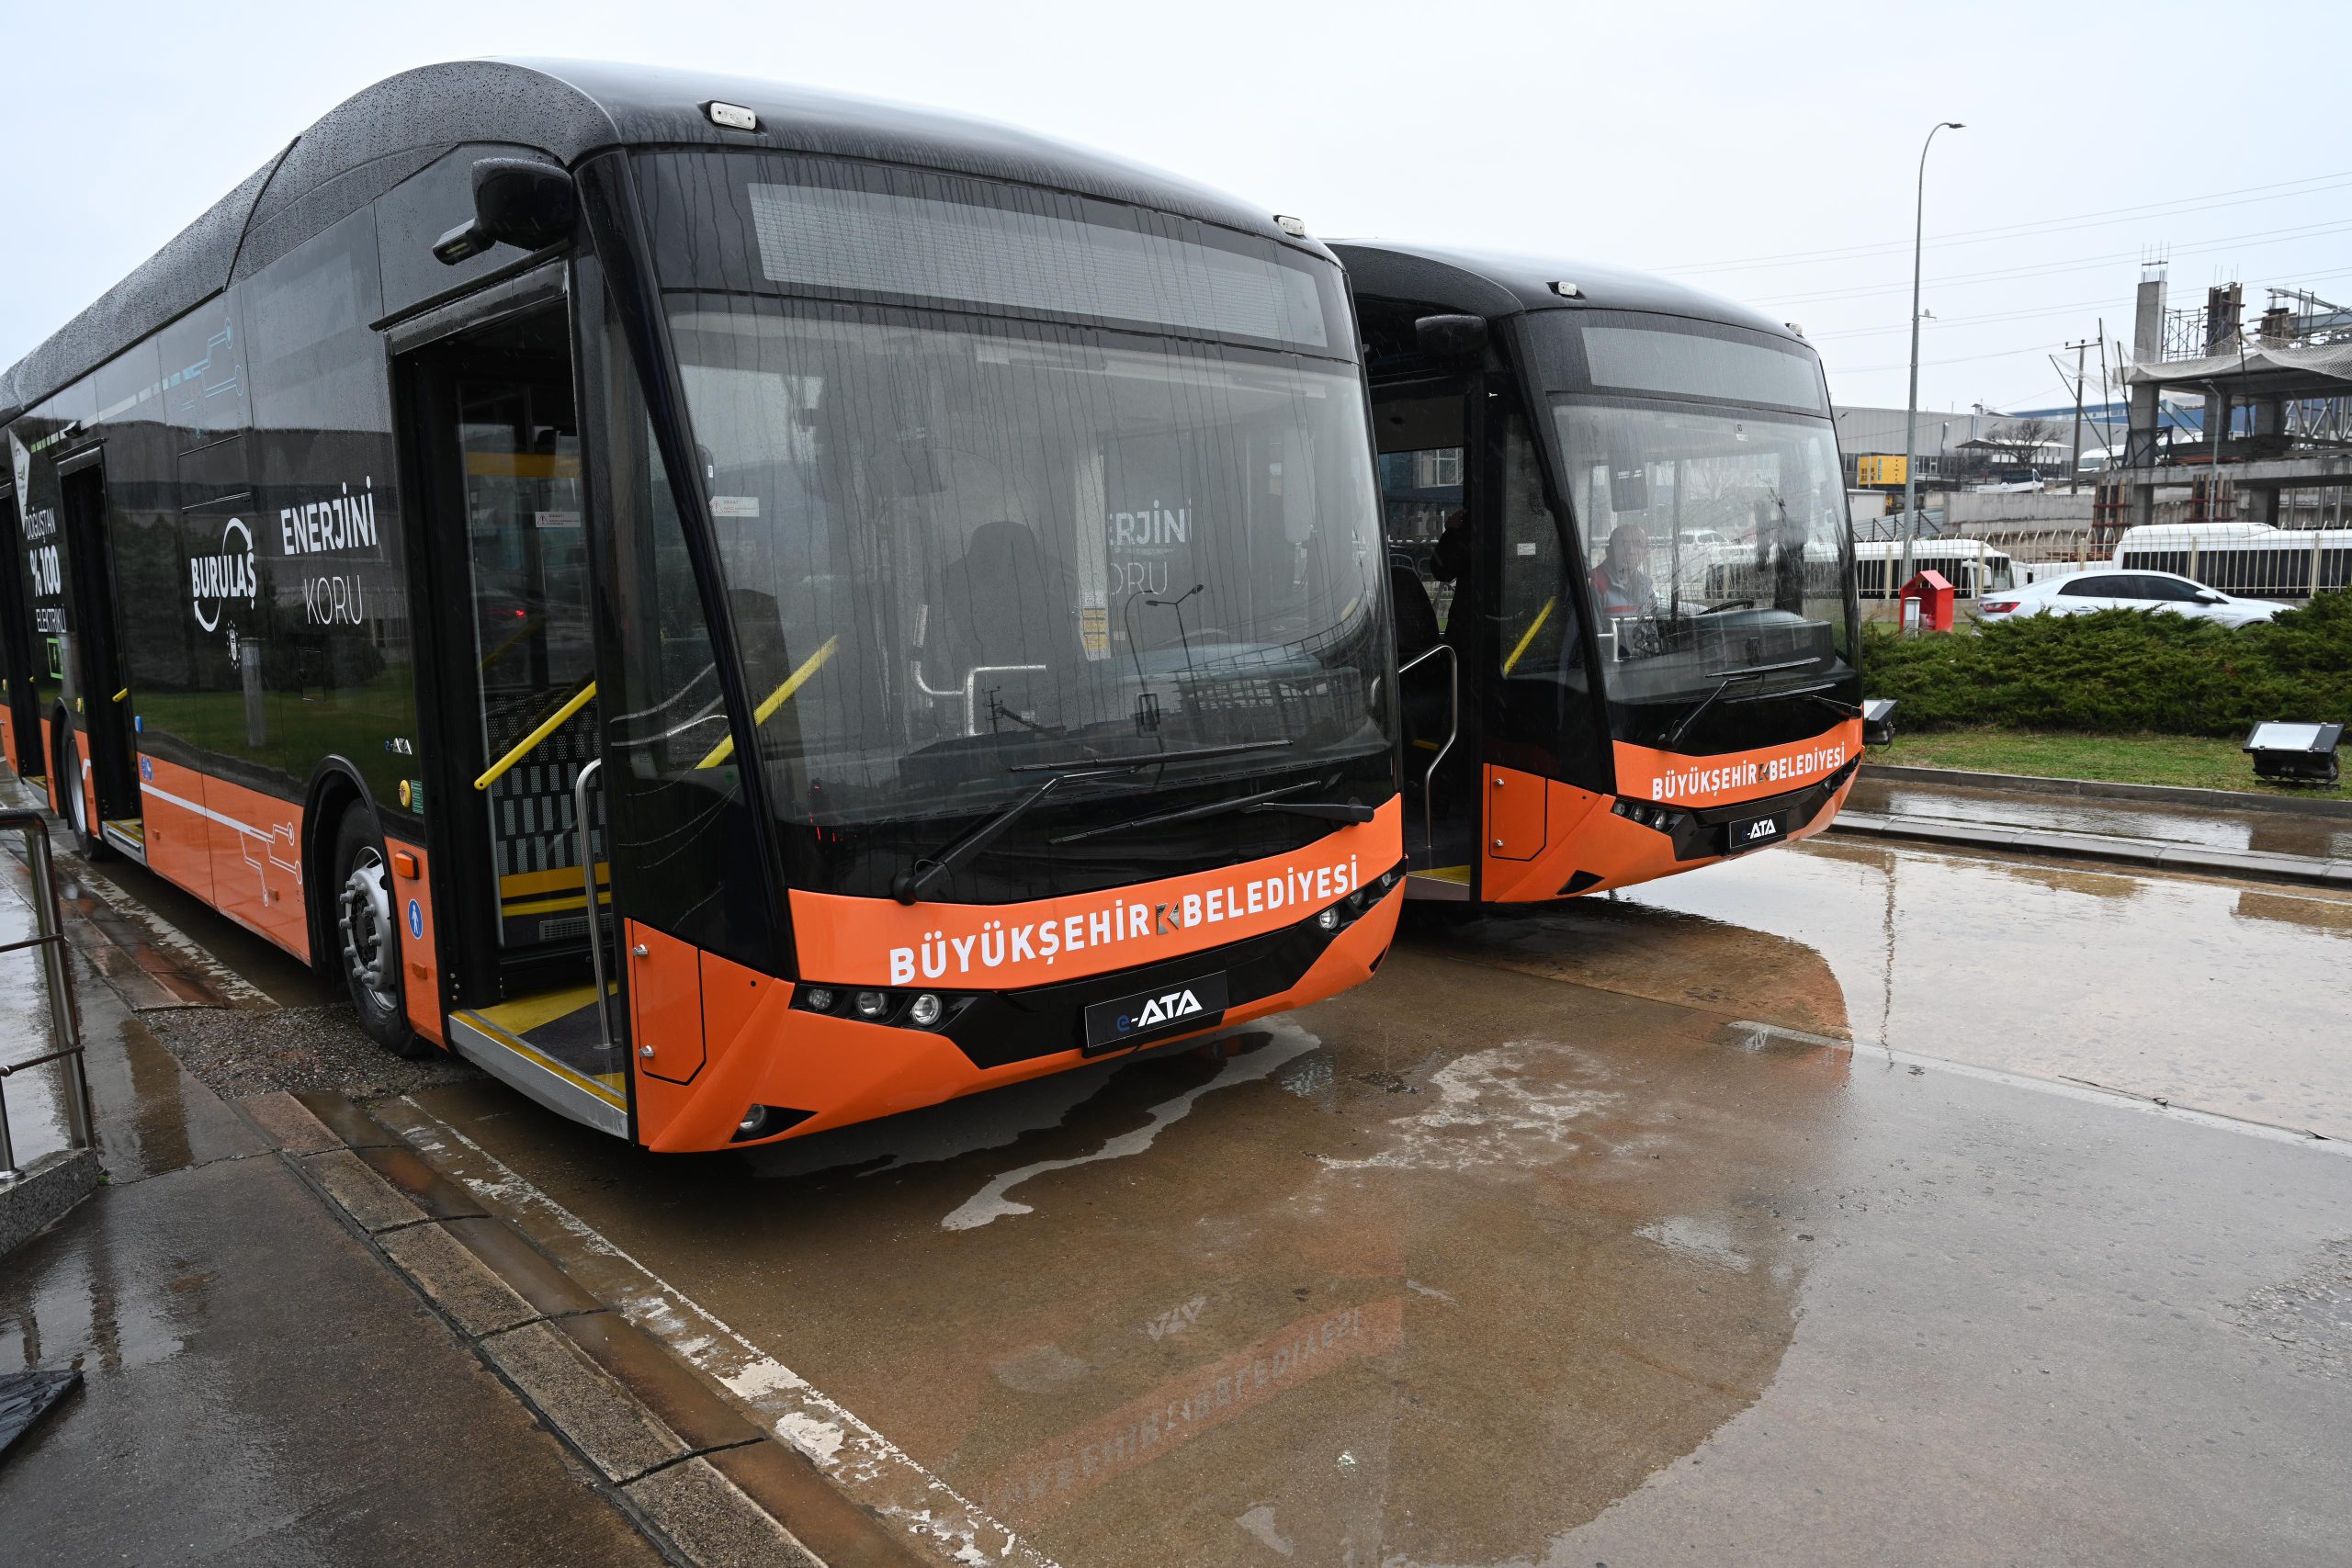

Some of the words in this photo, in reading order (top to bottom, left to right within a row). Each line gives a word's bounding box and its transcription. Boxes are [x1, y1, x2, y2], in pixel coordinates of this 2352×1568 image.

[25, 506, 56, 543] DOĞUŞTAN
[280, 475, 377, 555] ENERJİNİ
[29, 545, 61, 597] %100
[190, 551, 256, 610] BURULAŞ
[36, 603, 67, 633] ELEKTRİKLİ
[304, 574, 363, 625] KORU
[1652, 760, 1757, 800] BÜYÜKŞEHİR
[1770, 741, 1846, 781] BELEDİYESİ
[889, 898, 1150, 986] BÜYÜKŞEHİR
[1182, 854, 1358, 928] BELEDİYESİ
[1116, 989, 1203, 1032] e-ATA
